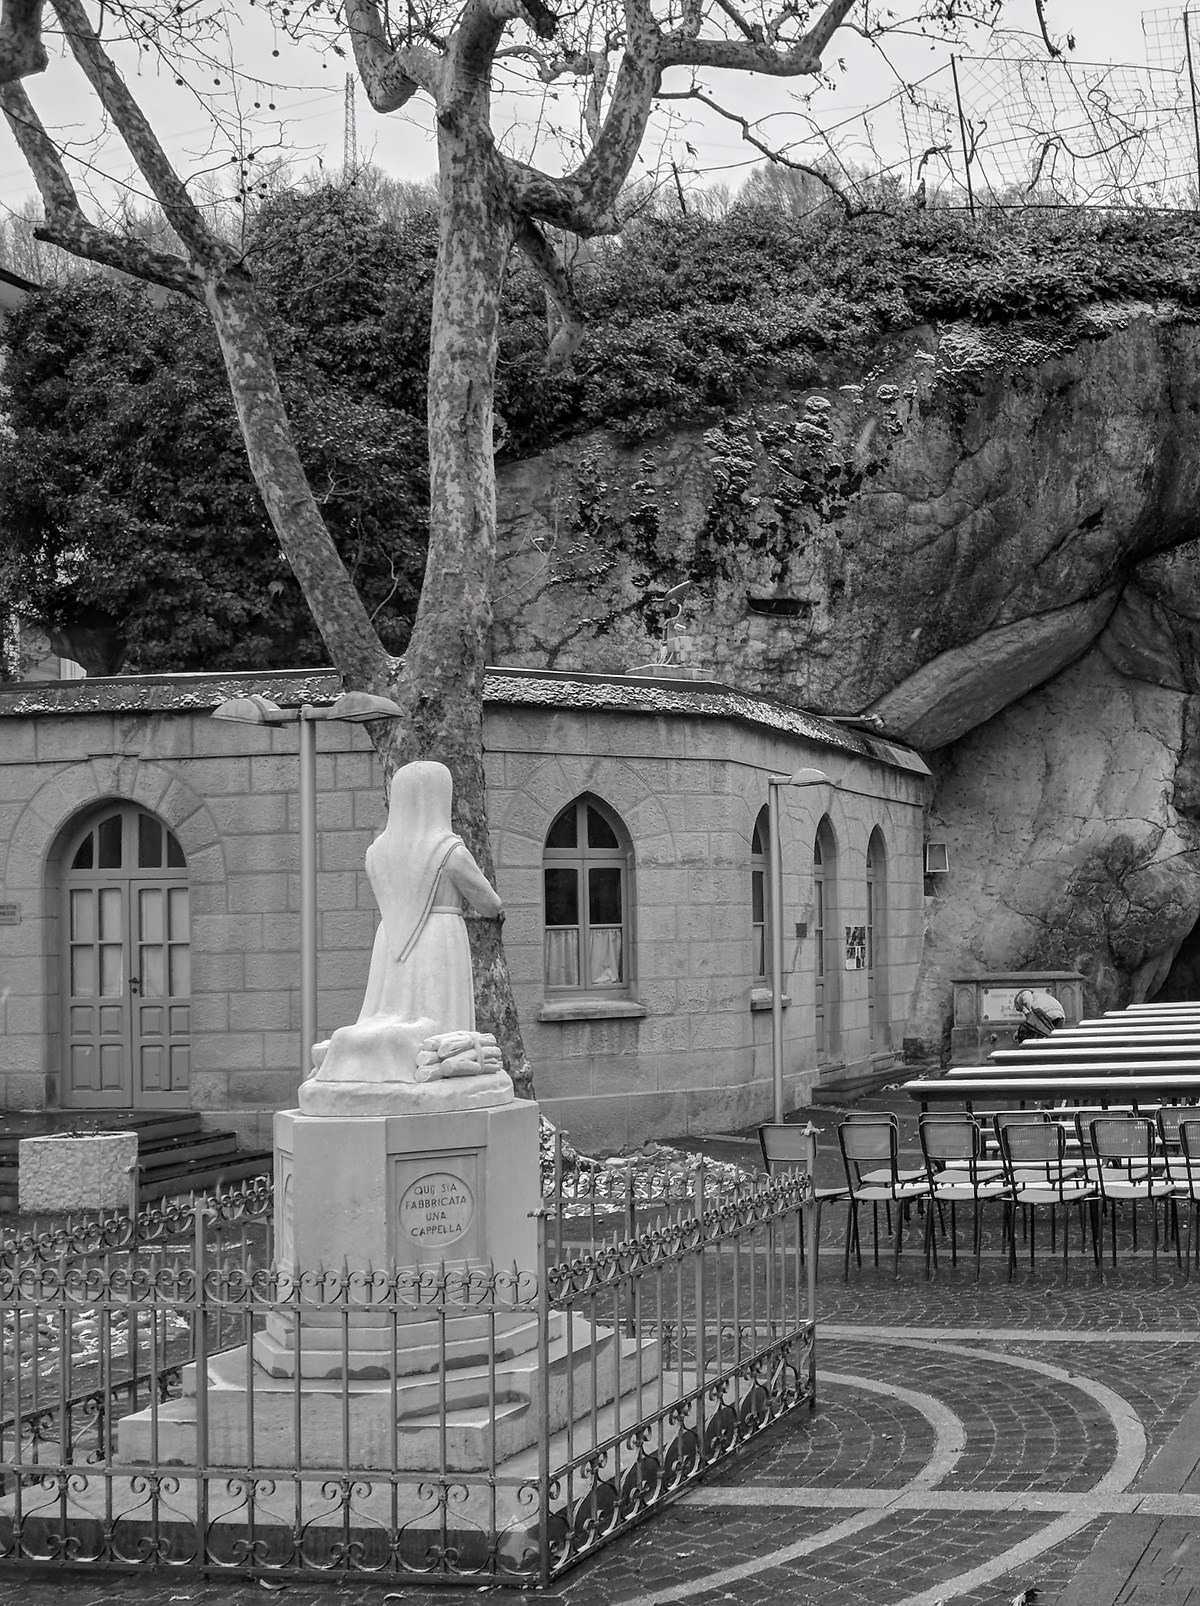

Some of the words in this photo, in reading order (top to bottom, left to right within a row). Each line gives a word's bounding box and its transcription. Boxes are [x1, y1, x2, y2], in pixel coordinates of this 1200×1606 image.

[441, 1183, 457, 1193] SIA
[405, 1196, 466, 1210] FABBRICATA
[426, 1211, 447, 1221] UNA
[411, 1223, 462, 1237] CAPPELLA
